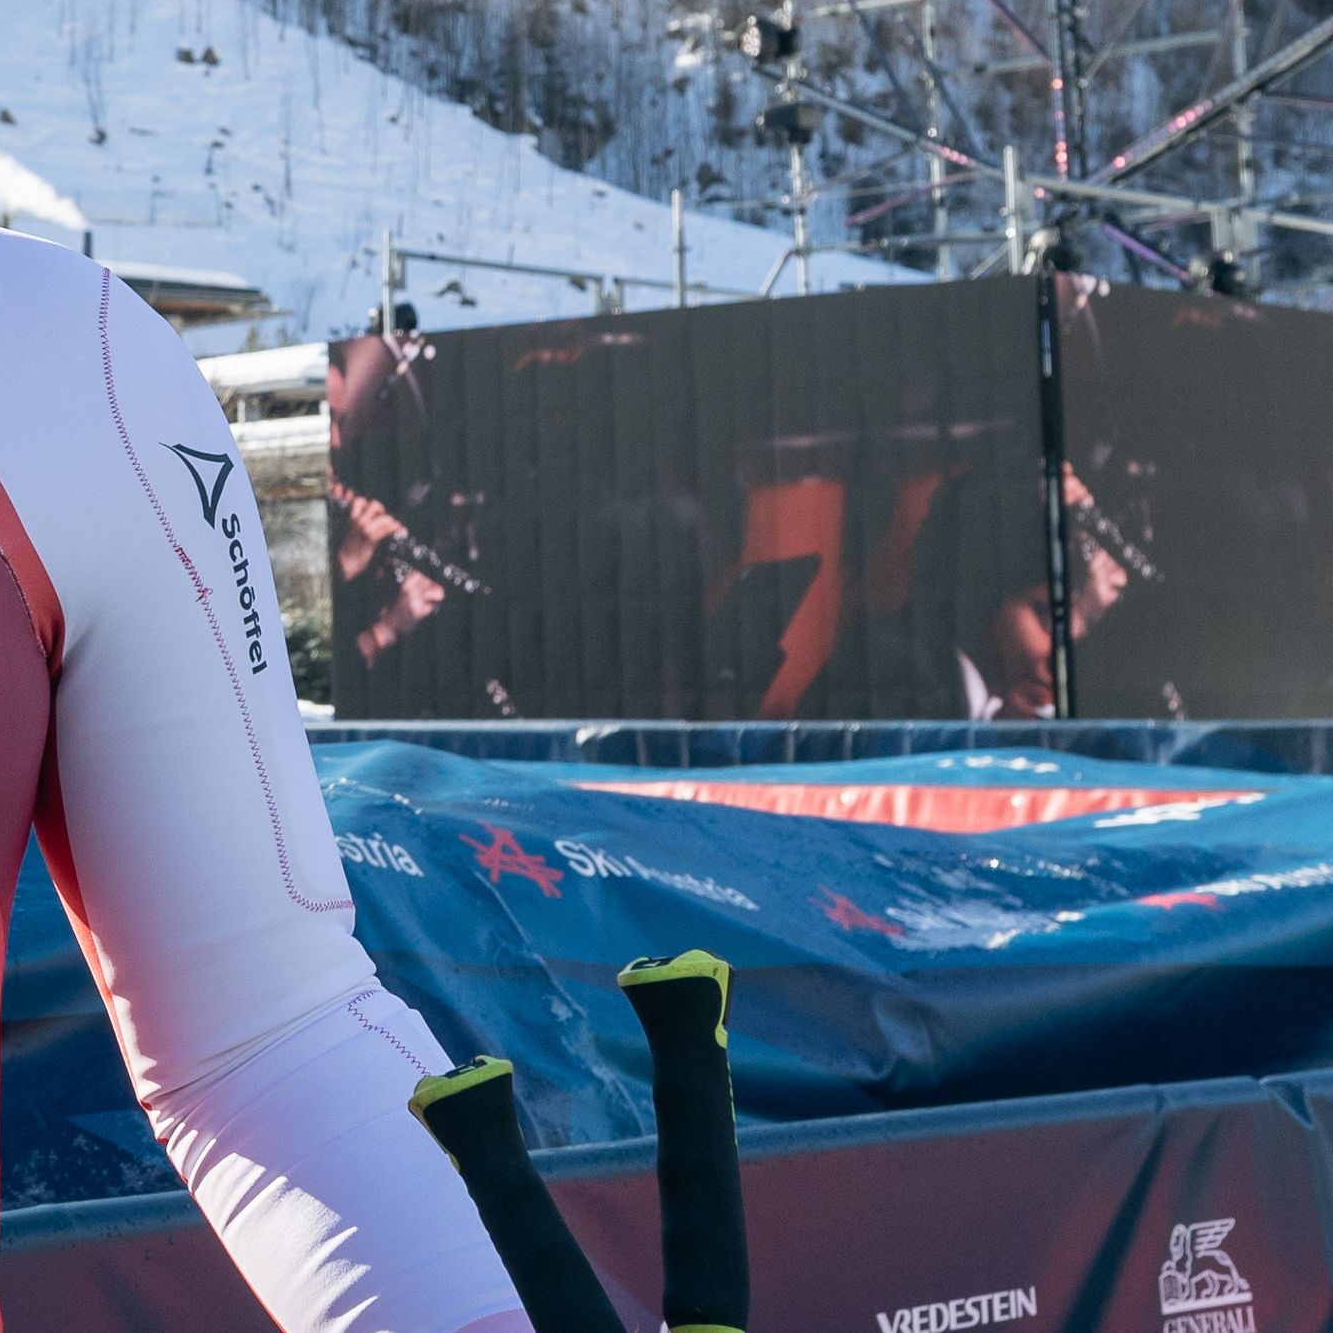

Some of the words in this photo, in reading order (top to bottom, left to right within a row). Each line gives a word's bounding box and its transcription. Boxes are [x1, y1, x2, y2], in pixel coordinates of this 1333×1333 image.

[222, 513, 268, 675] Schöffel
[554, 839, 633, 878] Ski
[876, 1285, 1037, 1333] VREDESTEIN
